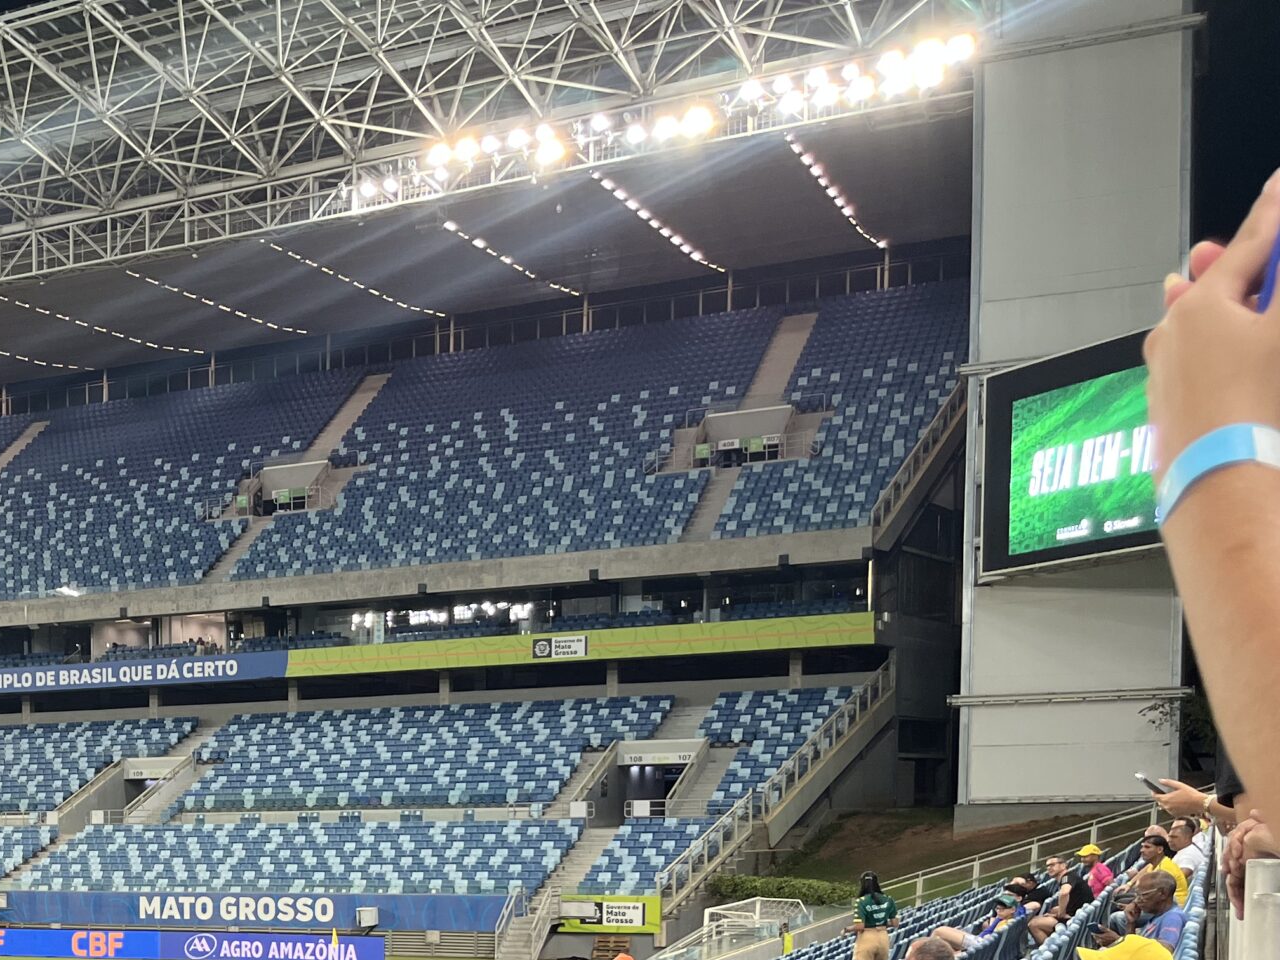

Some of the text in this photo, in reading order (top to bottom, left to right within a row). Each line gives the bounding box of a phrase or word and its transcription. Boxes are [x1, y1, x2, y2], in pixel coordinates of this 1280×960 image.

[1029, 443, 1073, 496] SEJA
[35, 671, 55, 686] DE
[59, 667, 116, 684] BRASIL
[119, 665, 152, 682] QUE
[156, 660, 179, 679] DÁ
[182, 660, 237, 678] CERTO
[139, 896, 334, 922] MATO GROSSO
[71, 931, 124, 957] CBF
[220, 940, 263, 958] AGRO
